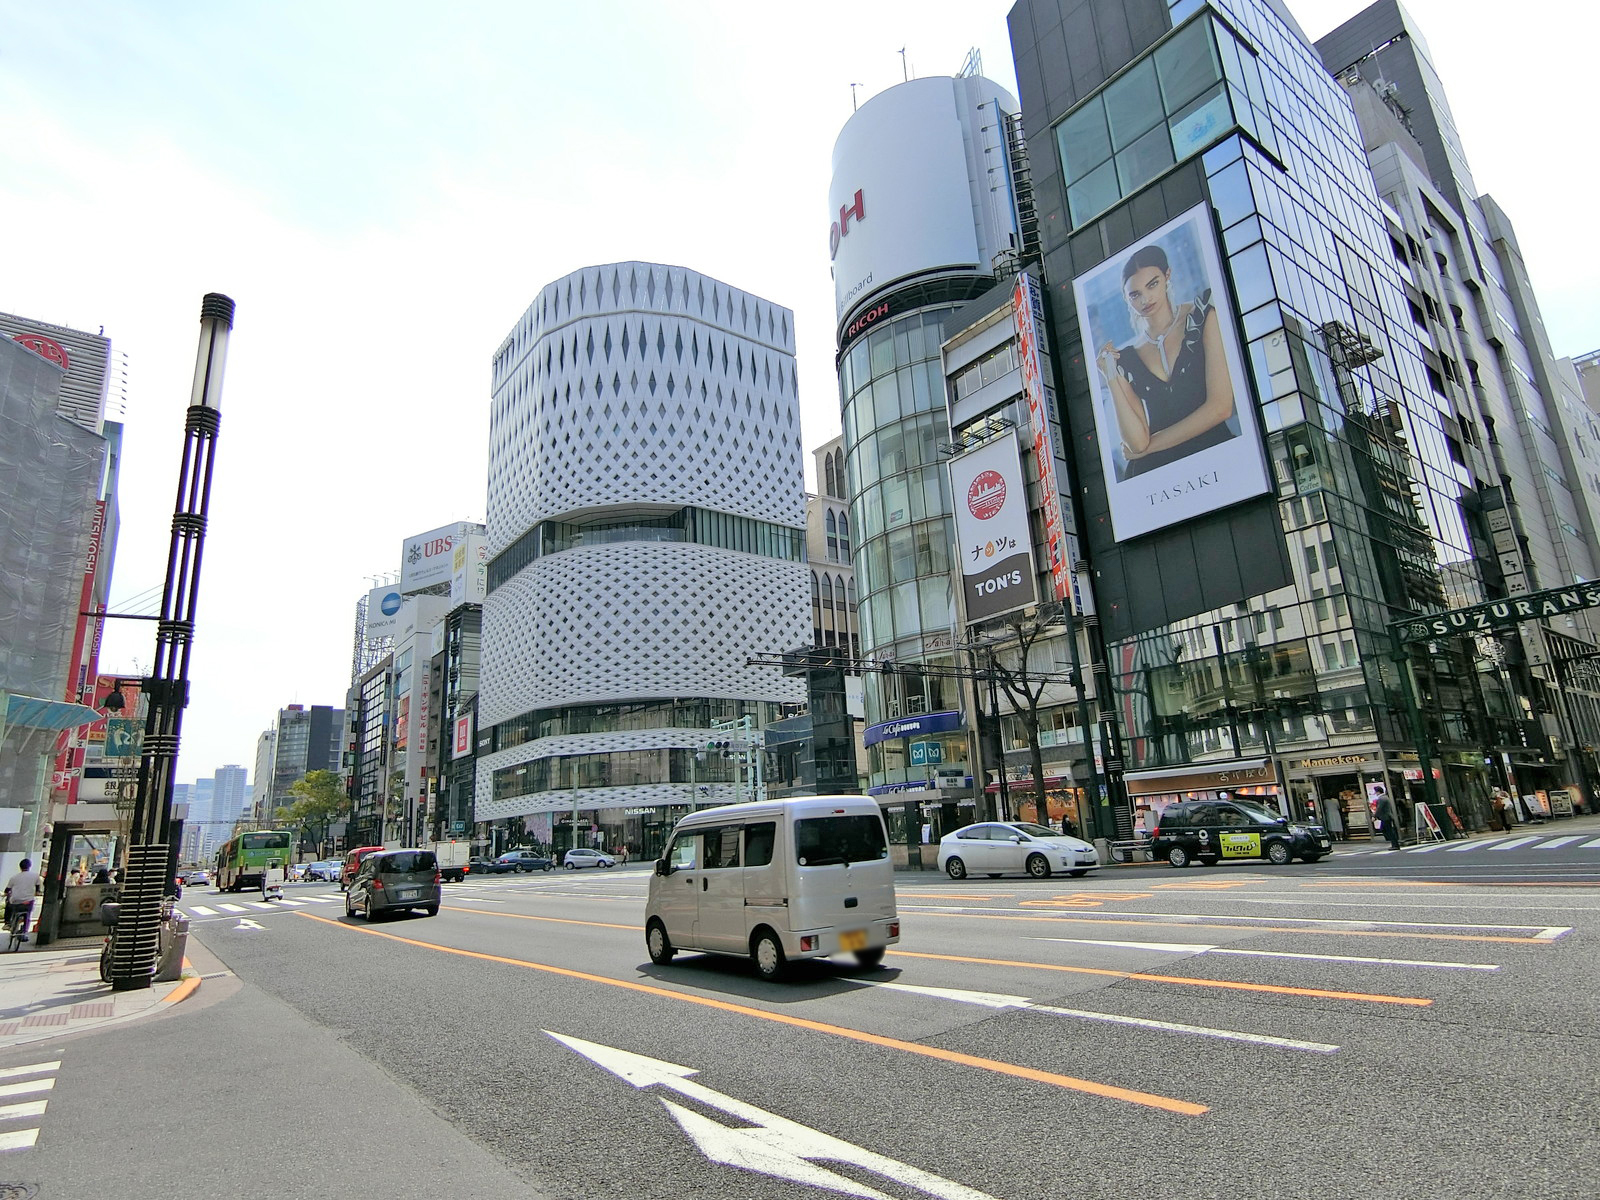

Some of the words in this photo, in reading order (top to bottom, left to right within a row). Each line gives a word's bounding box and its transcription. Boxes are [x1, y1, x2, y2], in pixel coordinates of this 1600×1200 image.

[848, 302, 889, 338] RICOH
[1146, 470, 1220, 506] TASAKI
[85, 503, 105, 575] MITSUKOSHI
[423, 535, 453, 559] UBS
[974, 570, 1022, 597] TON'S
[1432, 592, 1581, 635] SUZURAN
[479, 737, 491, 747] SONY
[624, 807, 656, 815] NISSAN
